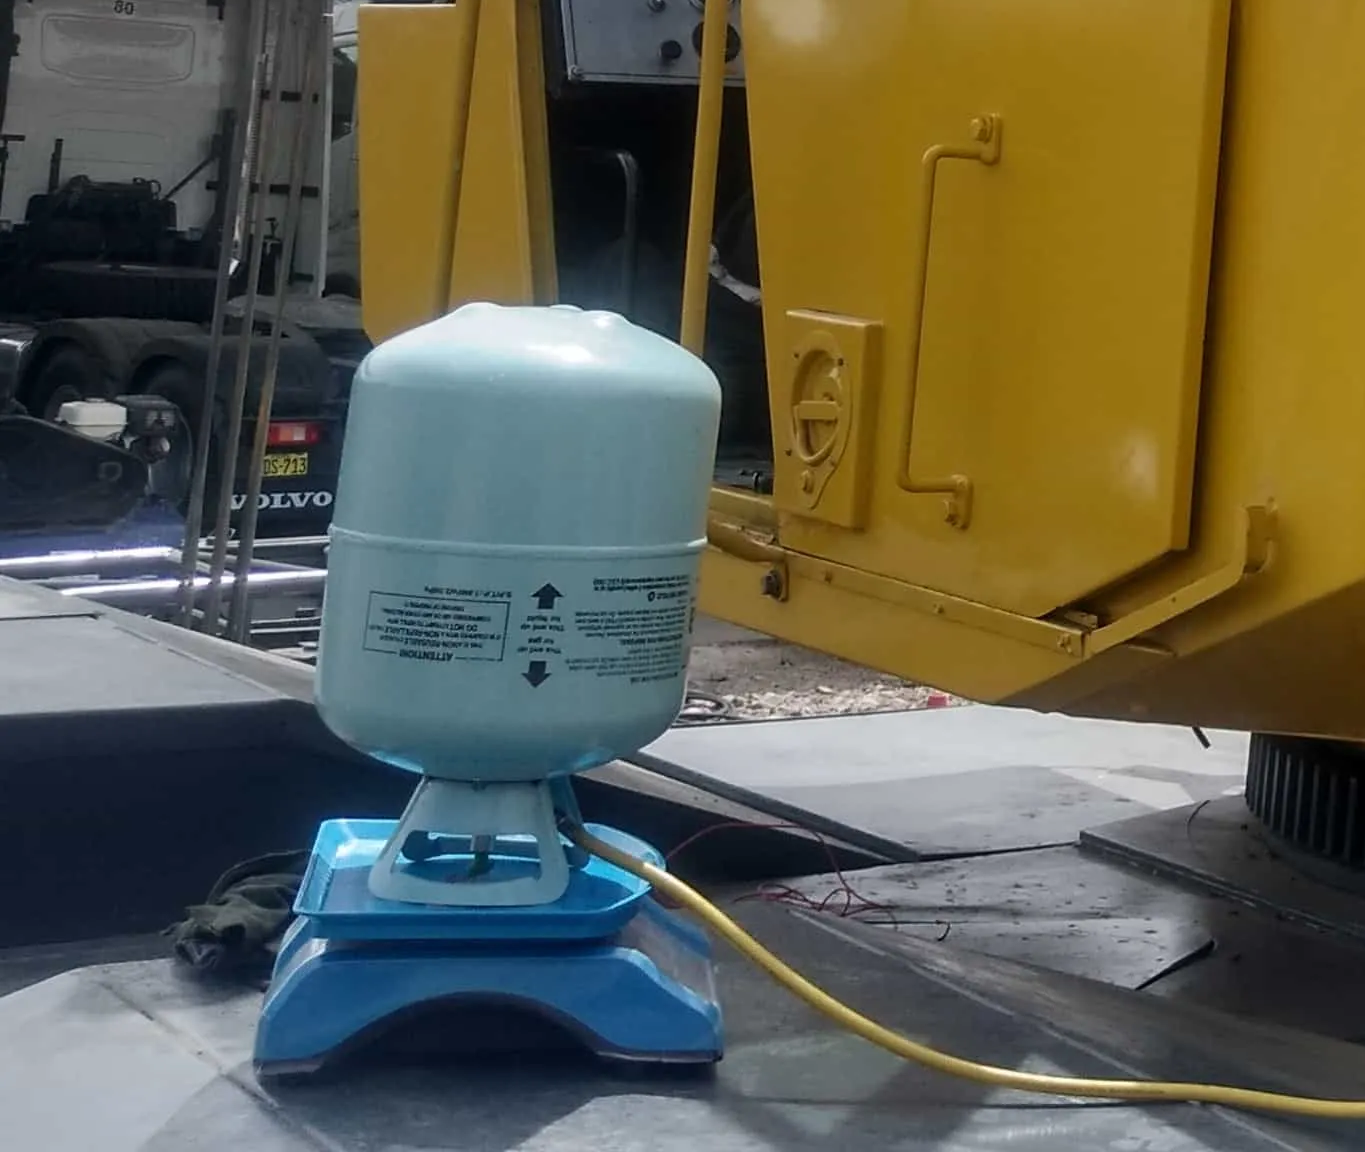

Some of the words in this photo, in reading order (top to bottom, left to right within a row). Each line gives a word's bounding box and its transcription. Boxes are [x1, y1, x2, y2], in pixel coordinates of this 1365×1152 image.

[113, 0, 134, 16] 80
[263, 458, 306, 474] DS-713
[230, 491, 333, 510] VOLVO
